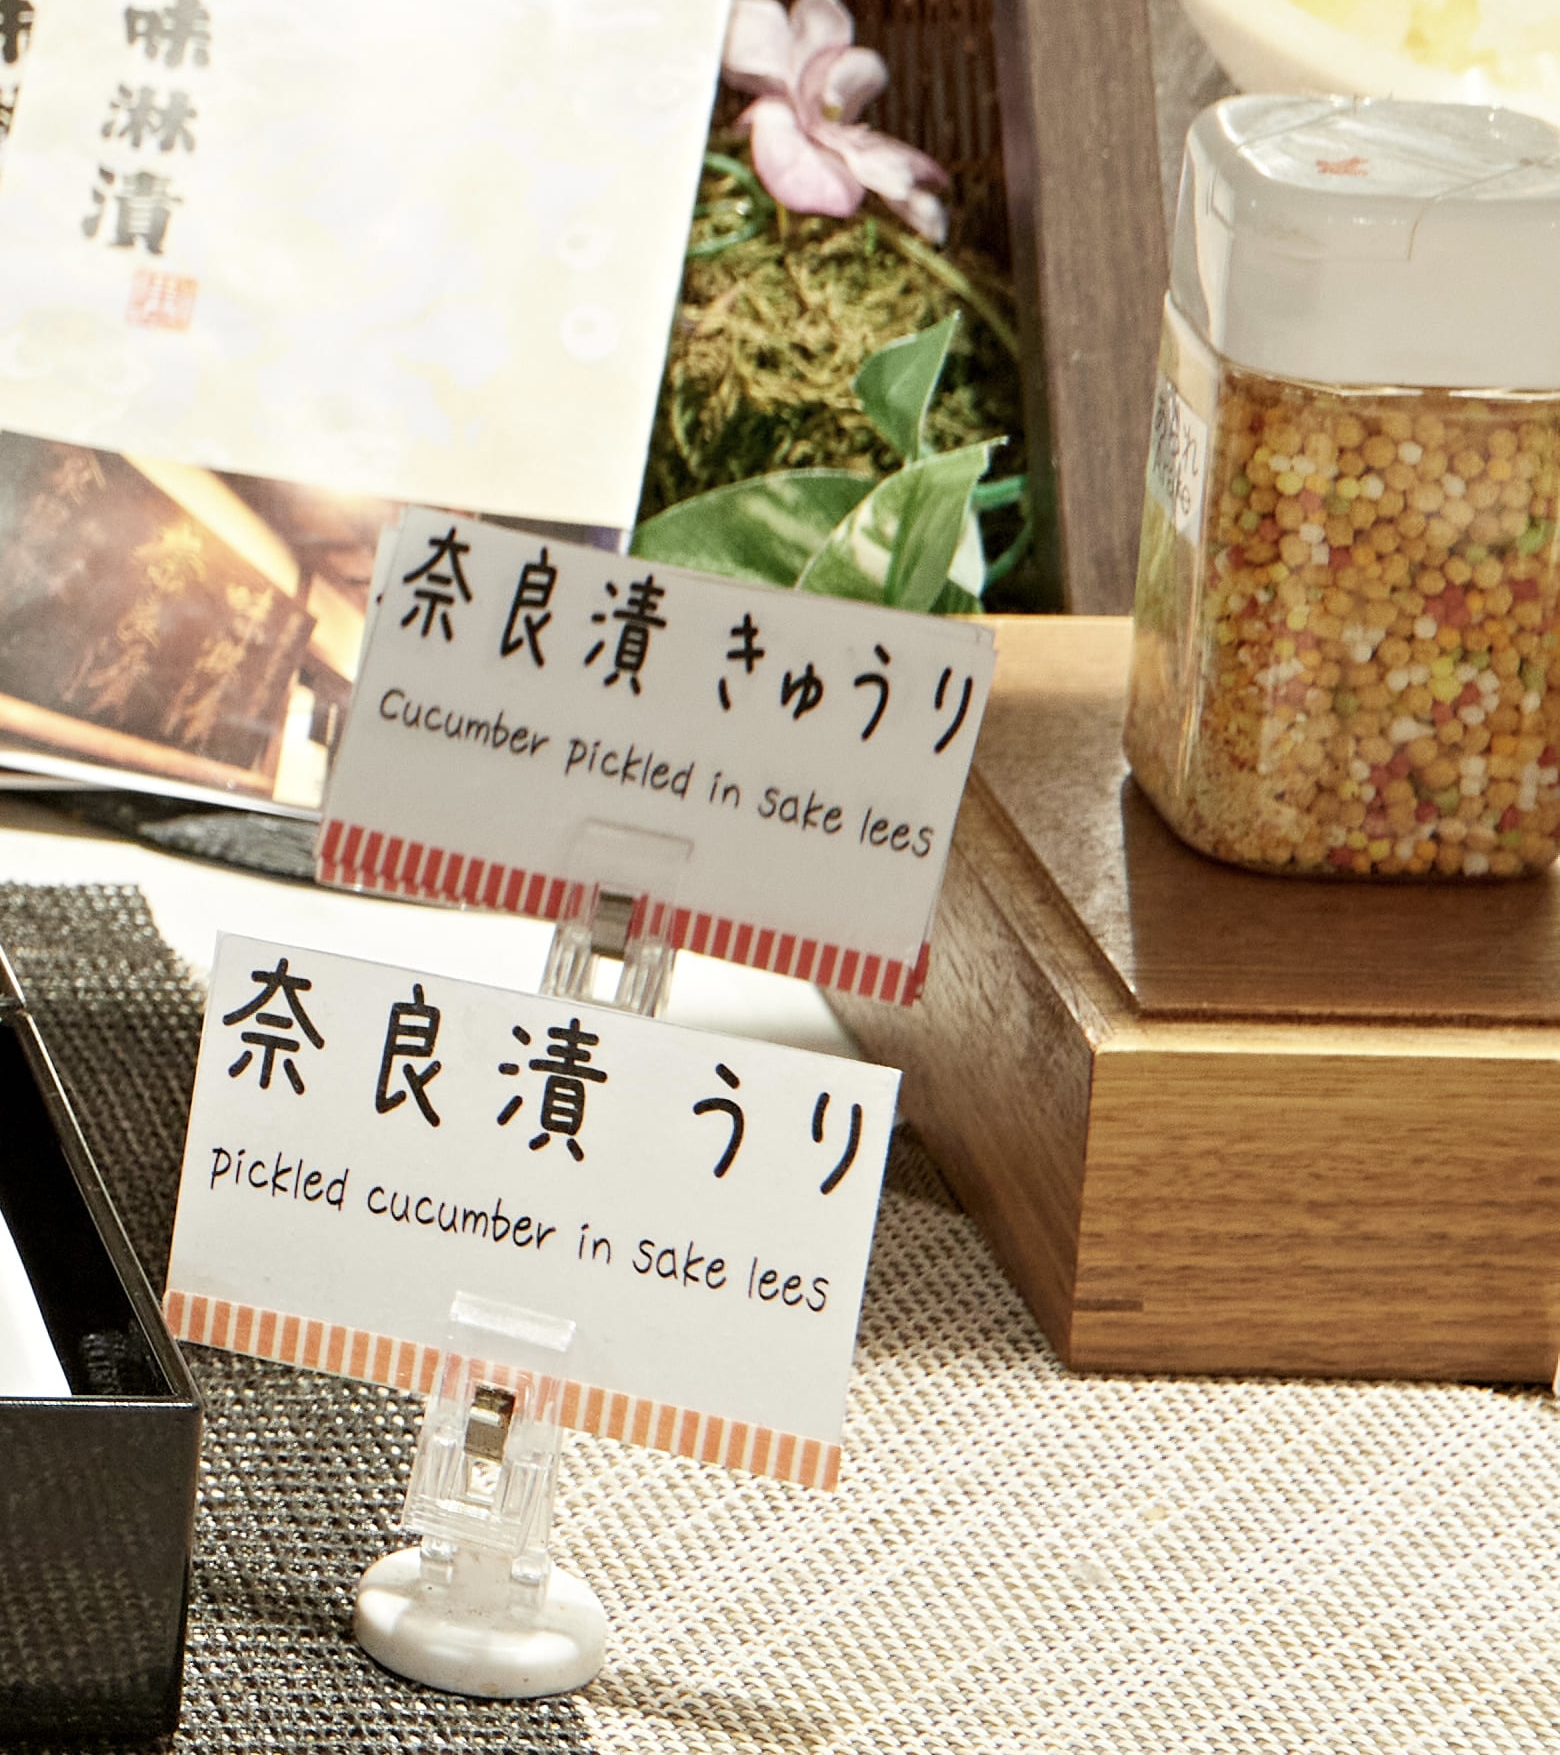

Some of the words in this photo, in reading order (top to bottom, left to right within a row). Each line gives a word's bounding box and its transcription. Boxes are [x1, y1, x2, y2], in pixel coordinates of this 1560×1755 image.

[400, 526, 667, 696] 奈良漬
[717, 612, 975, 755] きゅうり
[563, 737, 695, 801] pickled
[708, 770, 741, 810] in
[757, 786, 844, 835] sake
[860, 806, 935, 858] lees
[222, 957, 608, 1163] 奈良漬
[692, 1063, 863, 1196] うり
[209, 1147, 346, 1211] pickled
[366, 1184, 556, 1249] cucumber
[578, 1223, 612, 1265] in
[632, 1234, 727, 1290] sake
[748, 1256, 830, 1314] lees
